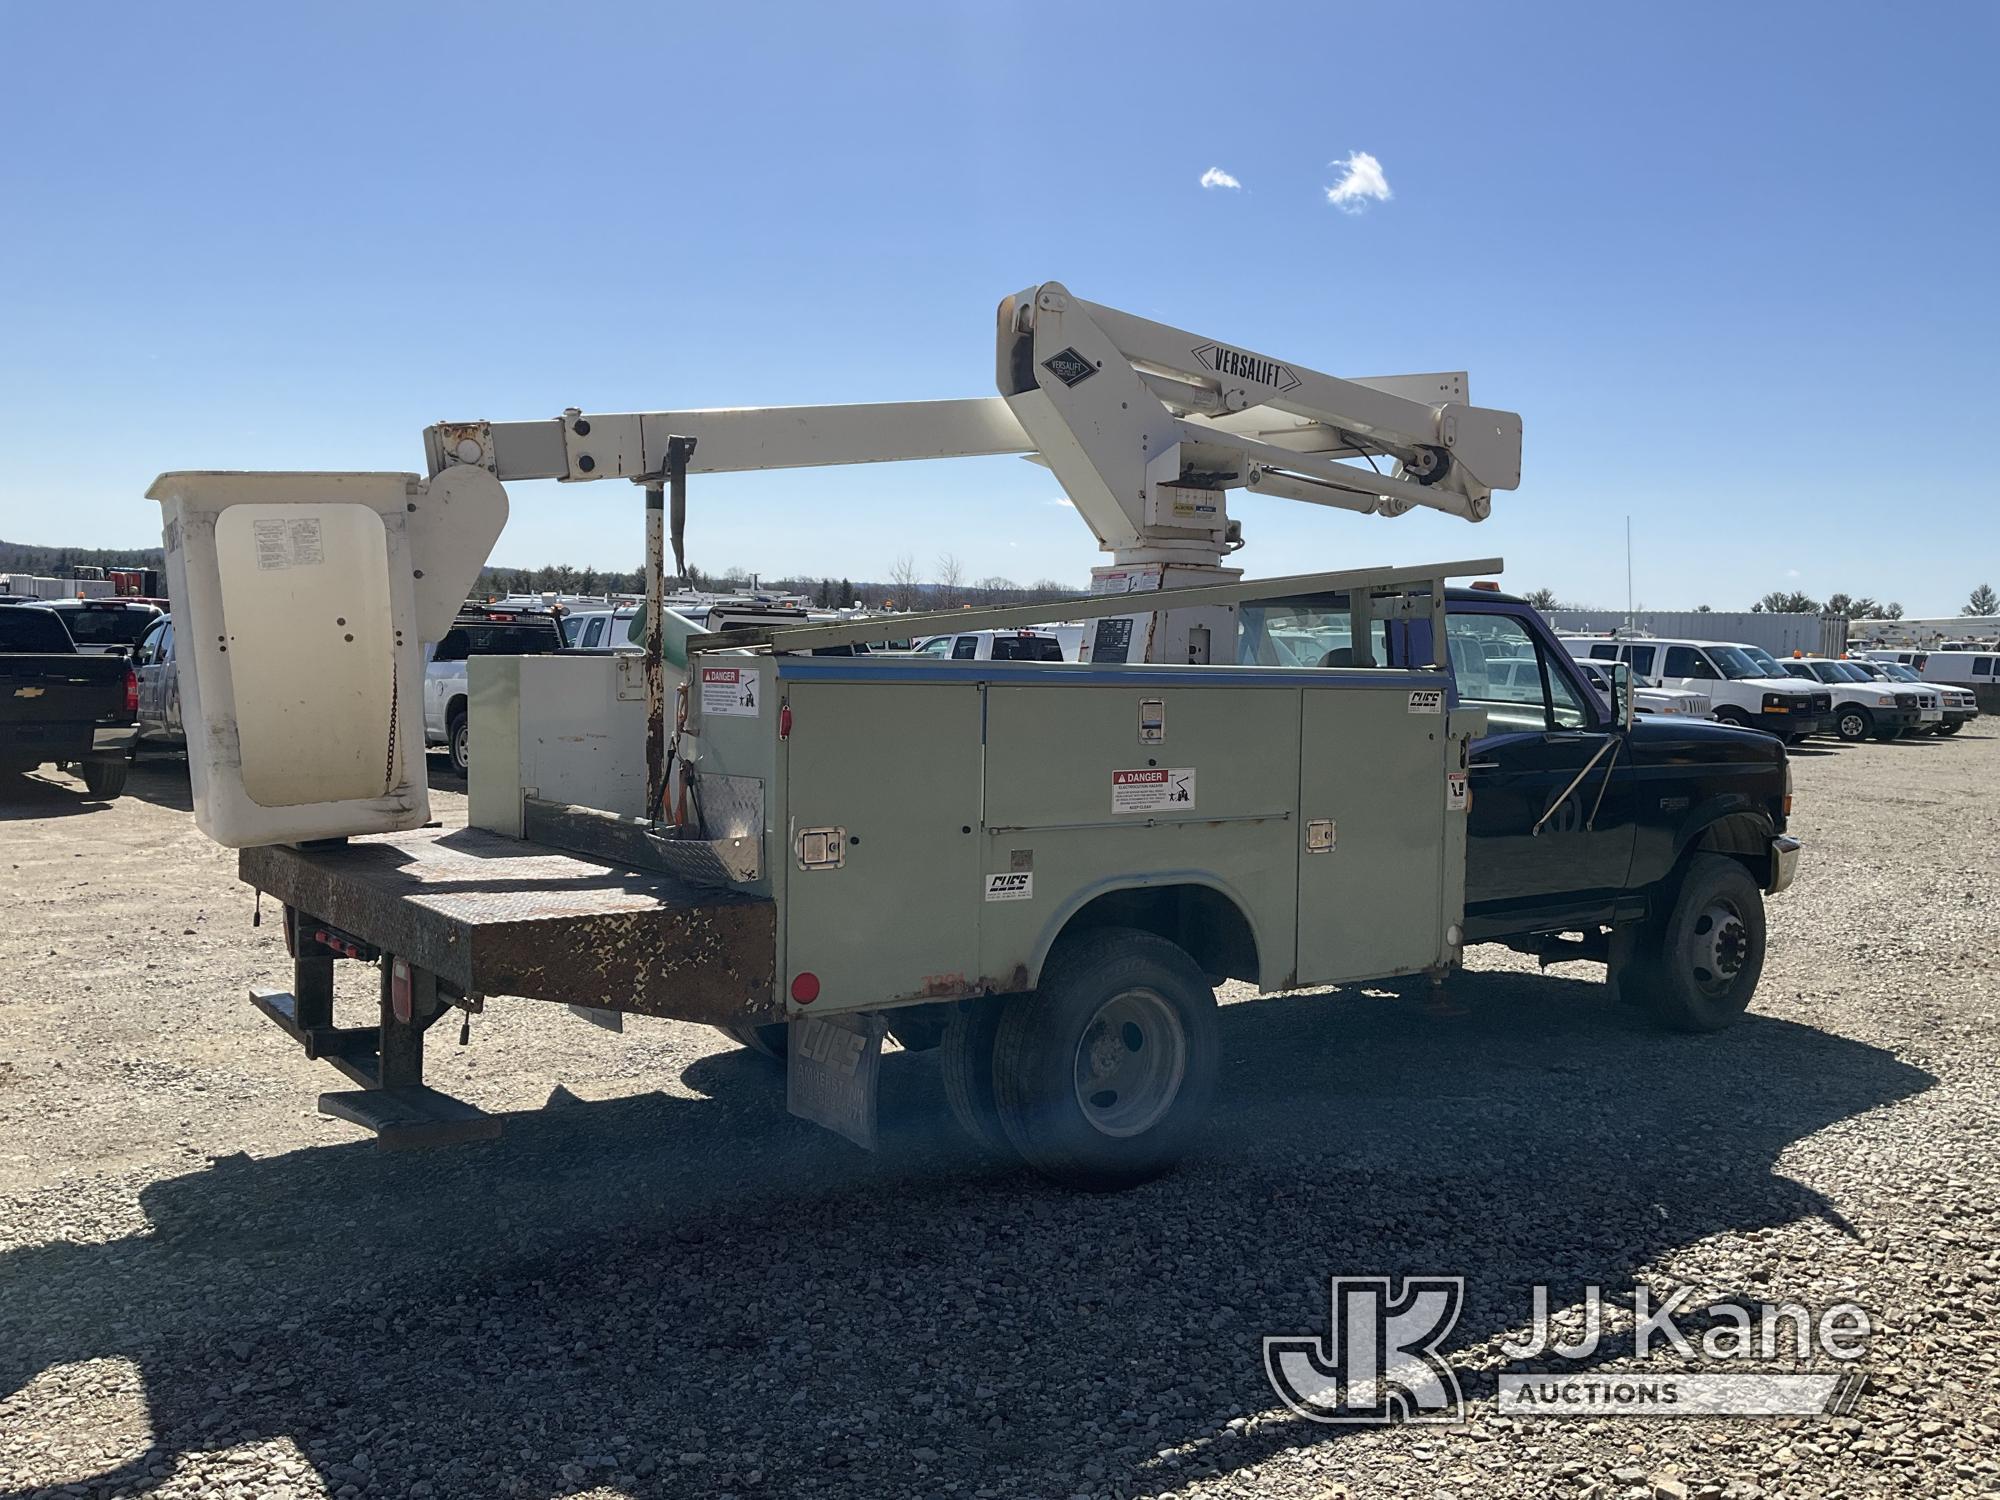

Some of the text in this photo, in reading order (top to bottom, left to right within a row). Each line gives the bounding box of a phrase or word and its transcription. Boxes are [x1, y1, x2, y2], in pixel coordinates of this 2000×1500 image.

[1051, 360, 1081, 371] VERSALIFT
[1215, 347, 1280, 387] VERSALIFT
[711, 671, 736, 681] DANGER
[1127, 772, 1162, 783] DANGER
